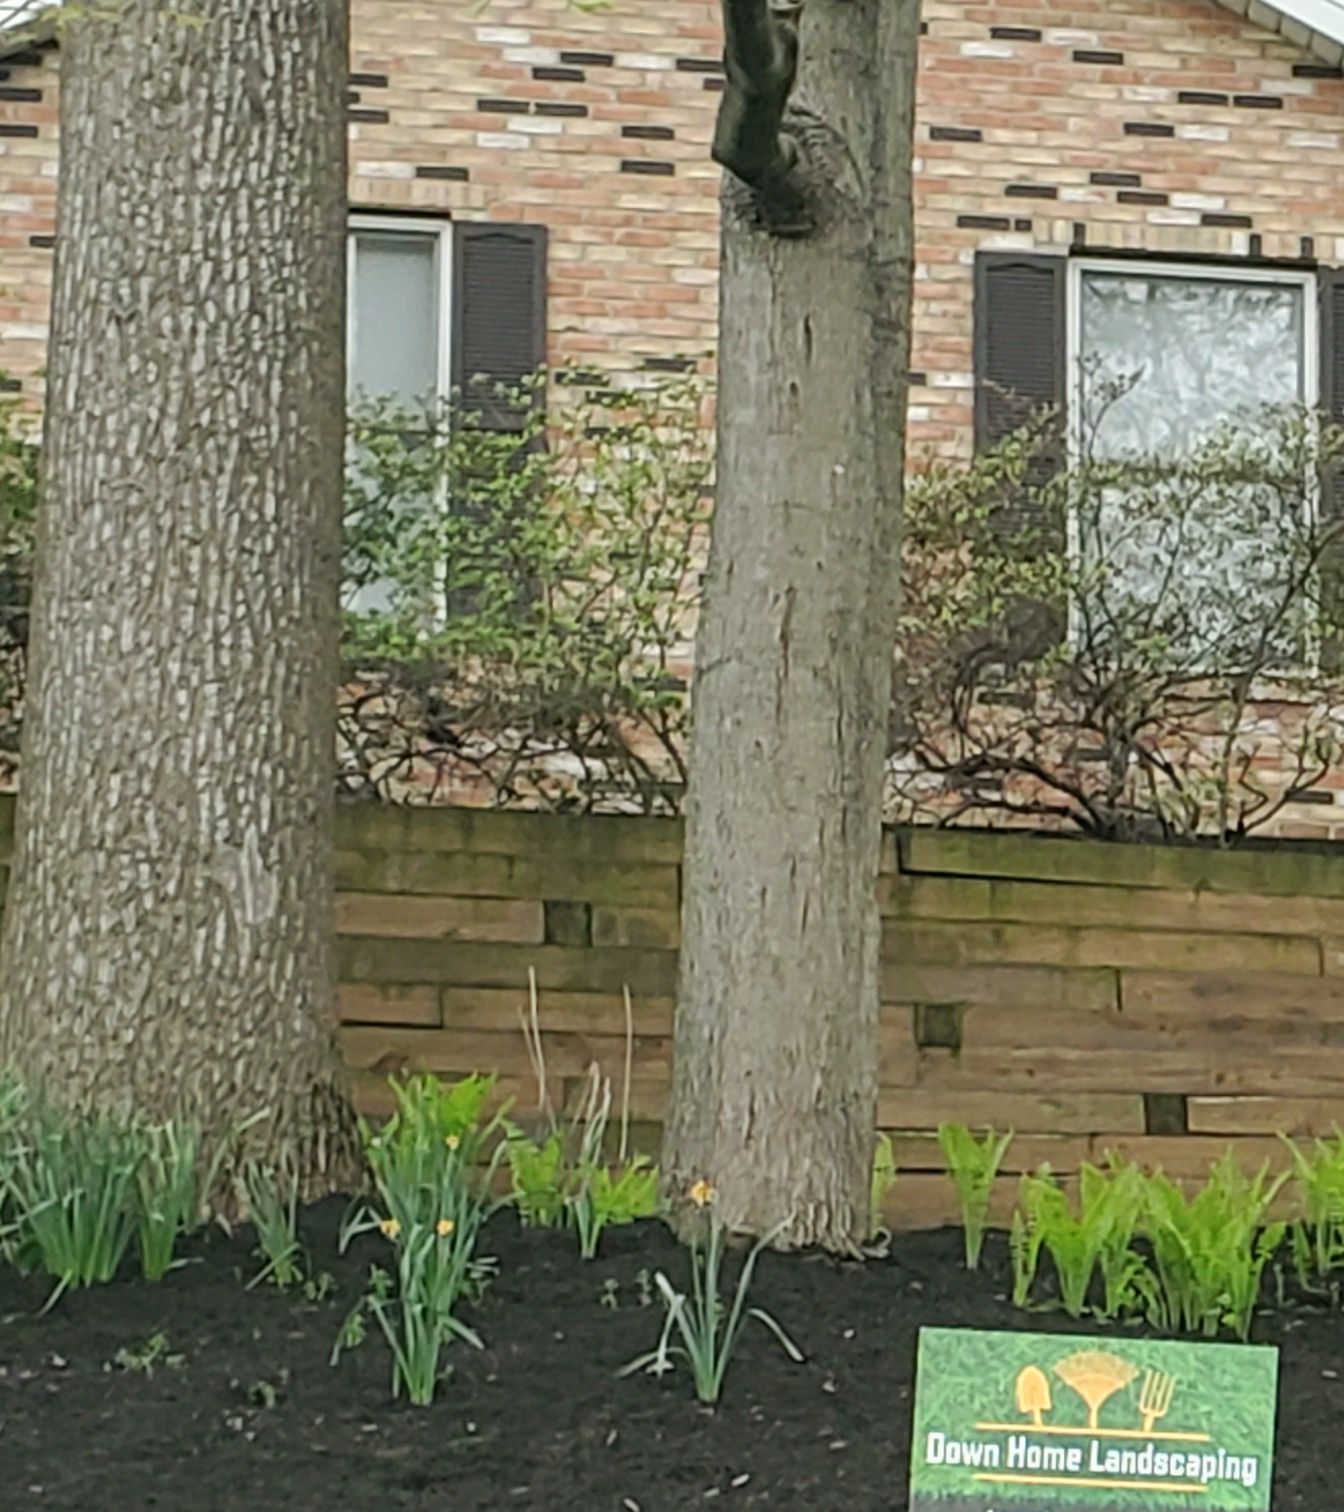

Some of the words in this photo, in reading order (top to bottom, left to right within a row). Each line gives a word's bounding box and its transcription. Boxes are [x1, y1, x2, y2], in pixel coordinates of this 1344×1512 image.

[926, 1432, 999, 1467] Down
[1006, 1436, 1082, 1470] Home
[1089, 1441, 1257, 1486] Landscaping
